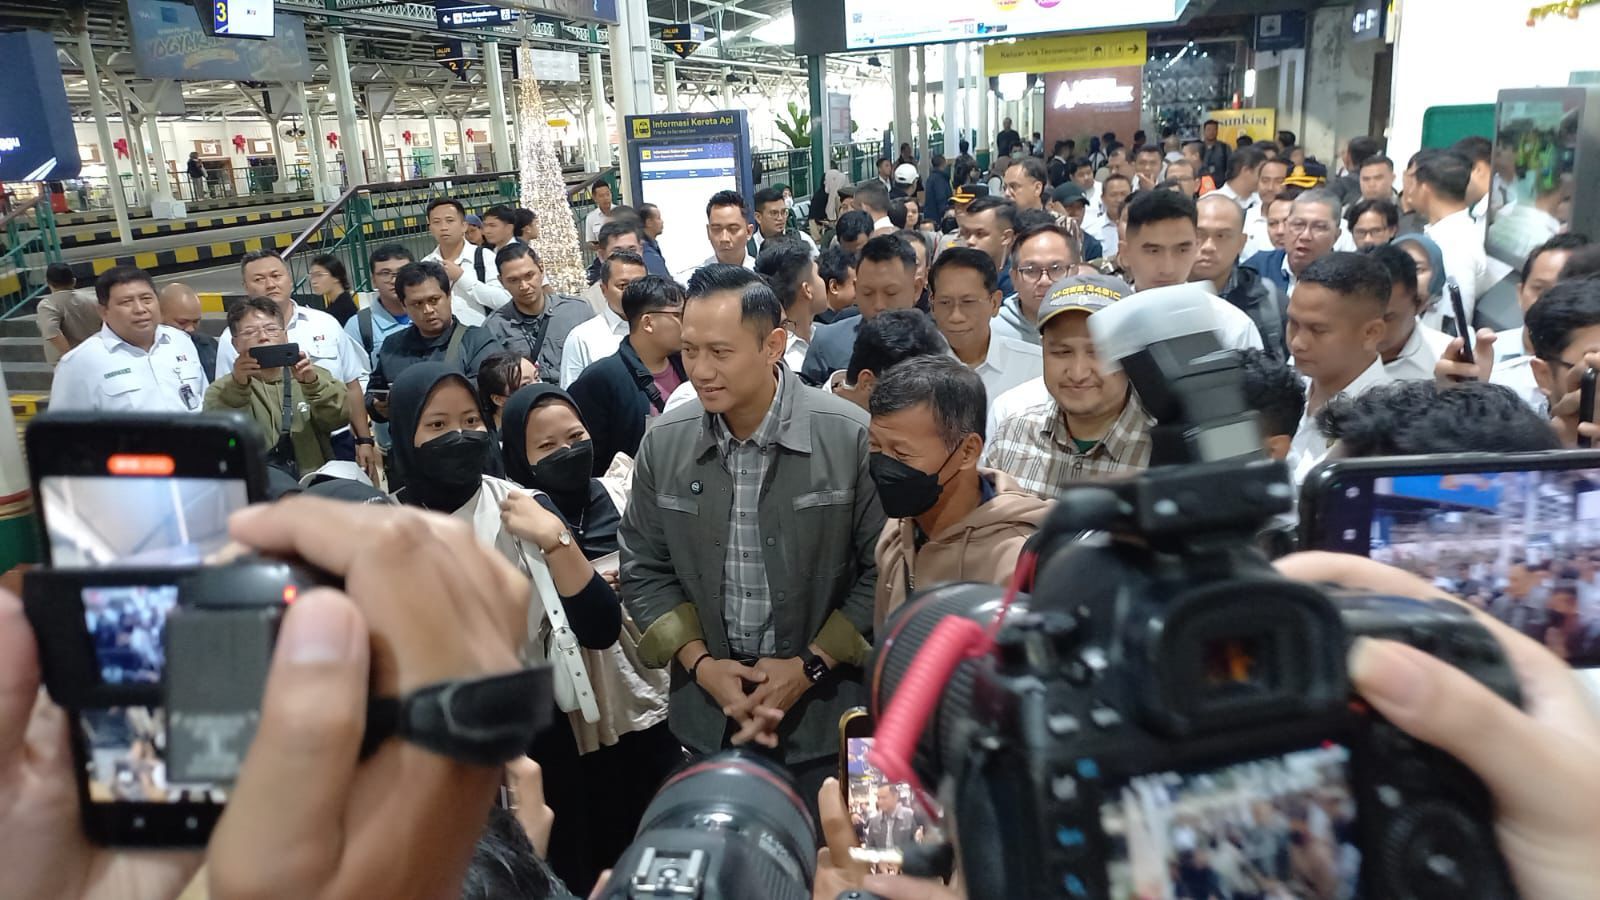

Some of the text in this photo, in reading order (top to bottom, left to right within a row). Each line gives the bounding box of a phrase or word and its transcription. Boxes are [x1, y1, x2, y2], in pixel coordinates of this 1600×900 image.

[216, 2, 227, 22] 3
[653, 116, 734, 129] Informasi Kereta Api
